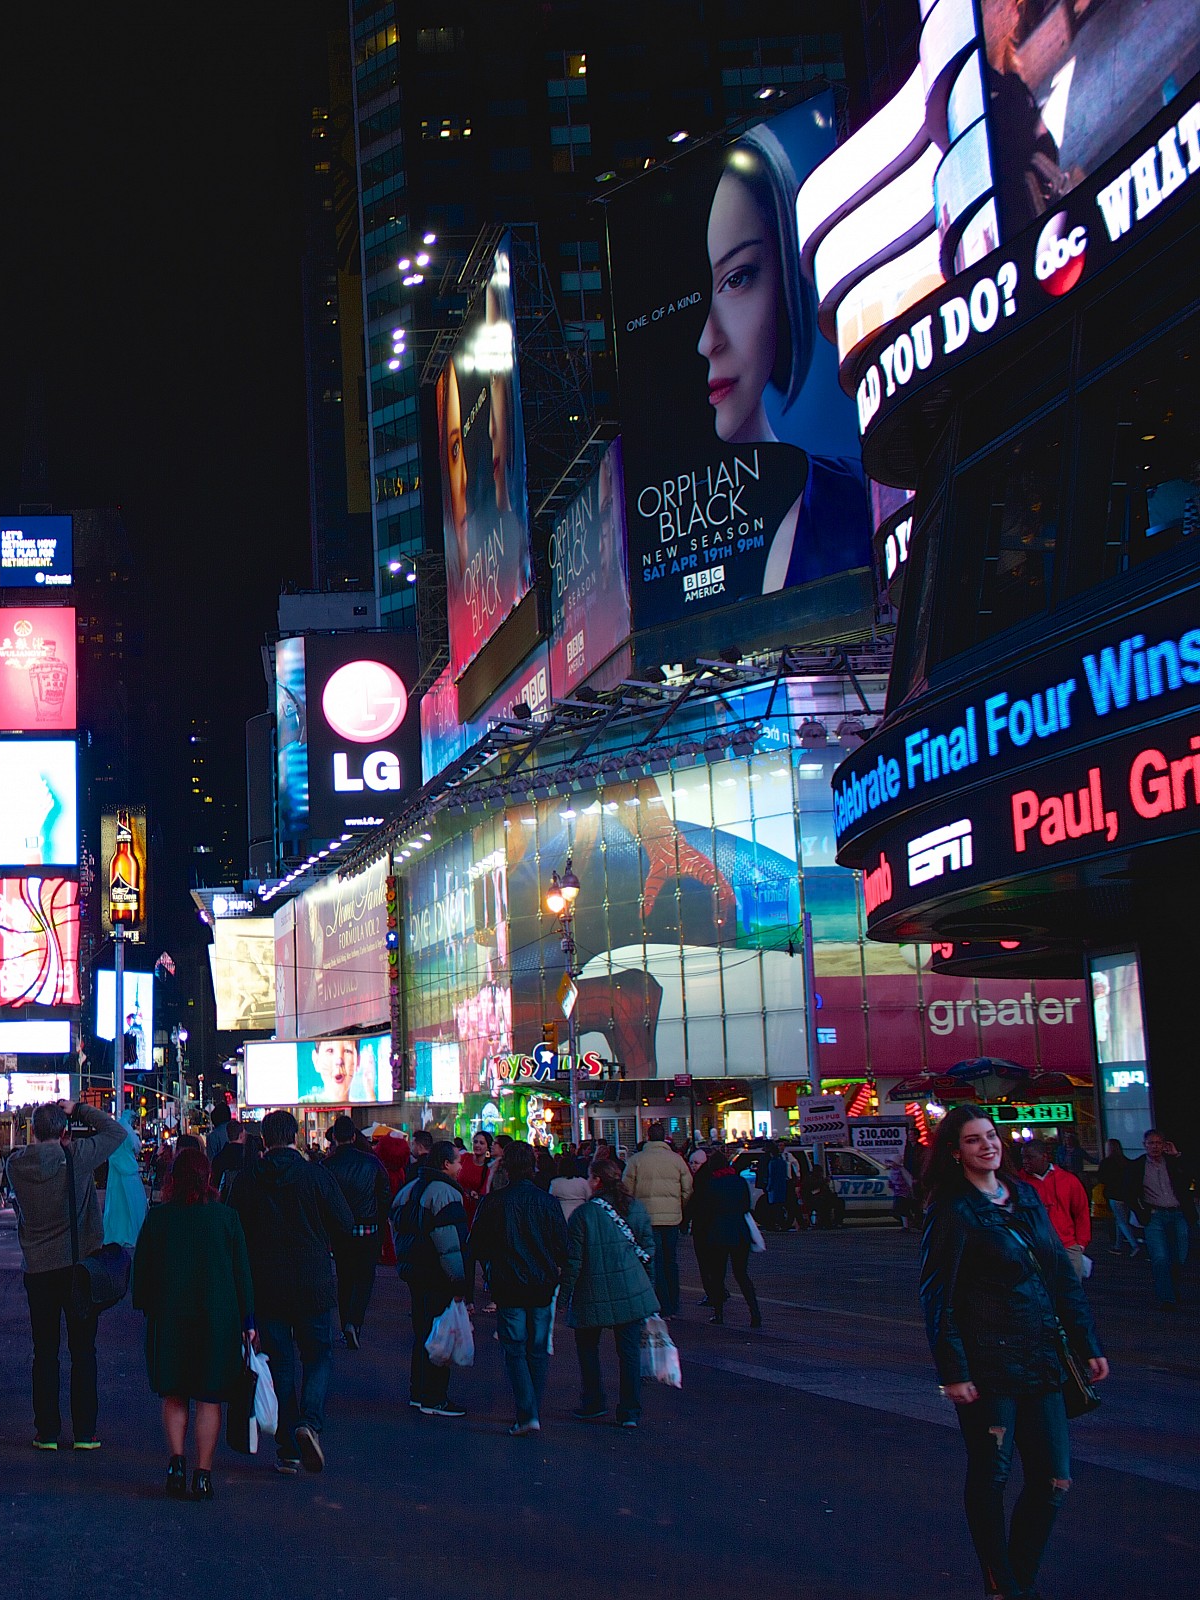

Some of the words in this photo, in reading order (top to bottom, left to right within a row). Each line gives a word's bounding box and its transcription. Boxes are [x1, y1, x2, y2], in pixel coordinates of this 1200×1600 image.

[651, 307, 665, 321] OF
[667, 303, 675, 315] A
[880, 314, 932, 397] YOU
[940, 261, 1018, 353] DO?
[637, 449, 759, 517] ORPHAN
[548, 483, 593, 569] ORPHAN
[659, 485, 748, 543] BLACK
[1, 557, 53, 567] RETIREMENT.
[463, 518, 504, 605] ORPHAN
[556, 529, 589, 597] BLACK
[642, 545, 678, 566] NEW
[690, 517, 764, 551] SEASON
[643, 563, 667, 582] SAT
[670, 554, 698, 574] APR
[702, 545, 732, 563] 19TH
[737, 535, 764, 552] 9PM
[568, 570, 596, 610] SEASON
[683, 565, 725, 591] BBC
[684, 583, 725, 602] AMERICA
[471, 565, 502, 637] BLACK
[566, 630, 584, 663] BBC
[568, 652, 586, 677] AMERICA
[905, 706, 978, 790] Final
[985, 677, 1076, 757] Four
[333, 751, 400, 791] LG
[1010, 767, 1117, 853] Paul,
[386, 876, 397, 927] TOYS
[338, 925, 365, 950] FORMULA
[365, 920, 375, 939] VOL
[376, 916, 380, 934] 2
[927, 991, 1081, 1036] greater
[494, 1054, 532, 1080] TOYS
[859, 1129, 900, 1139] $10,000
[838, 1181, 885, 1194] NYPD
